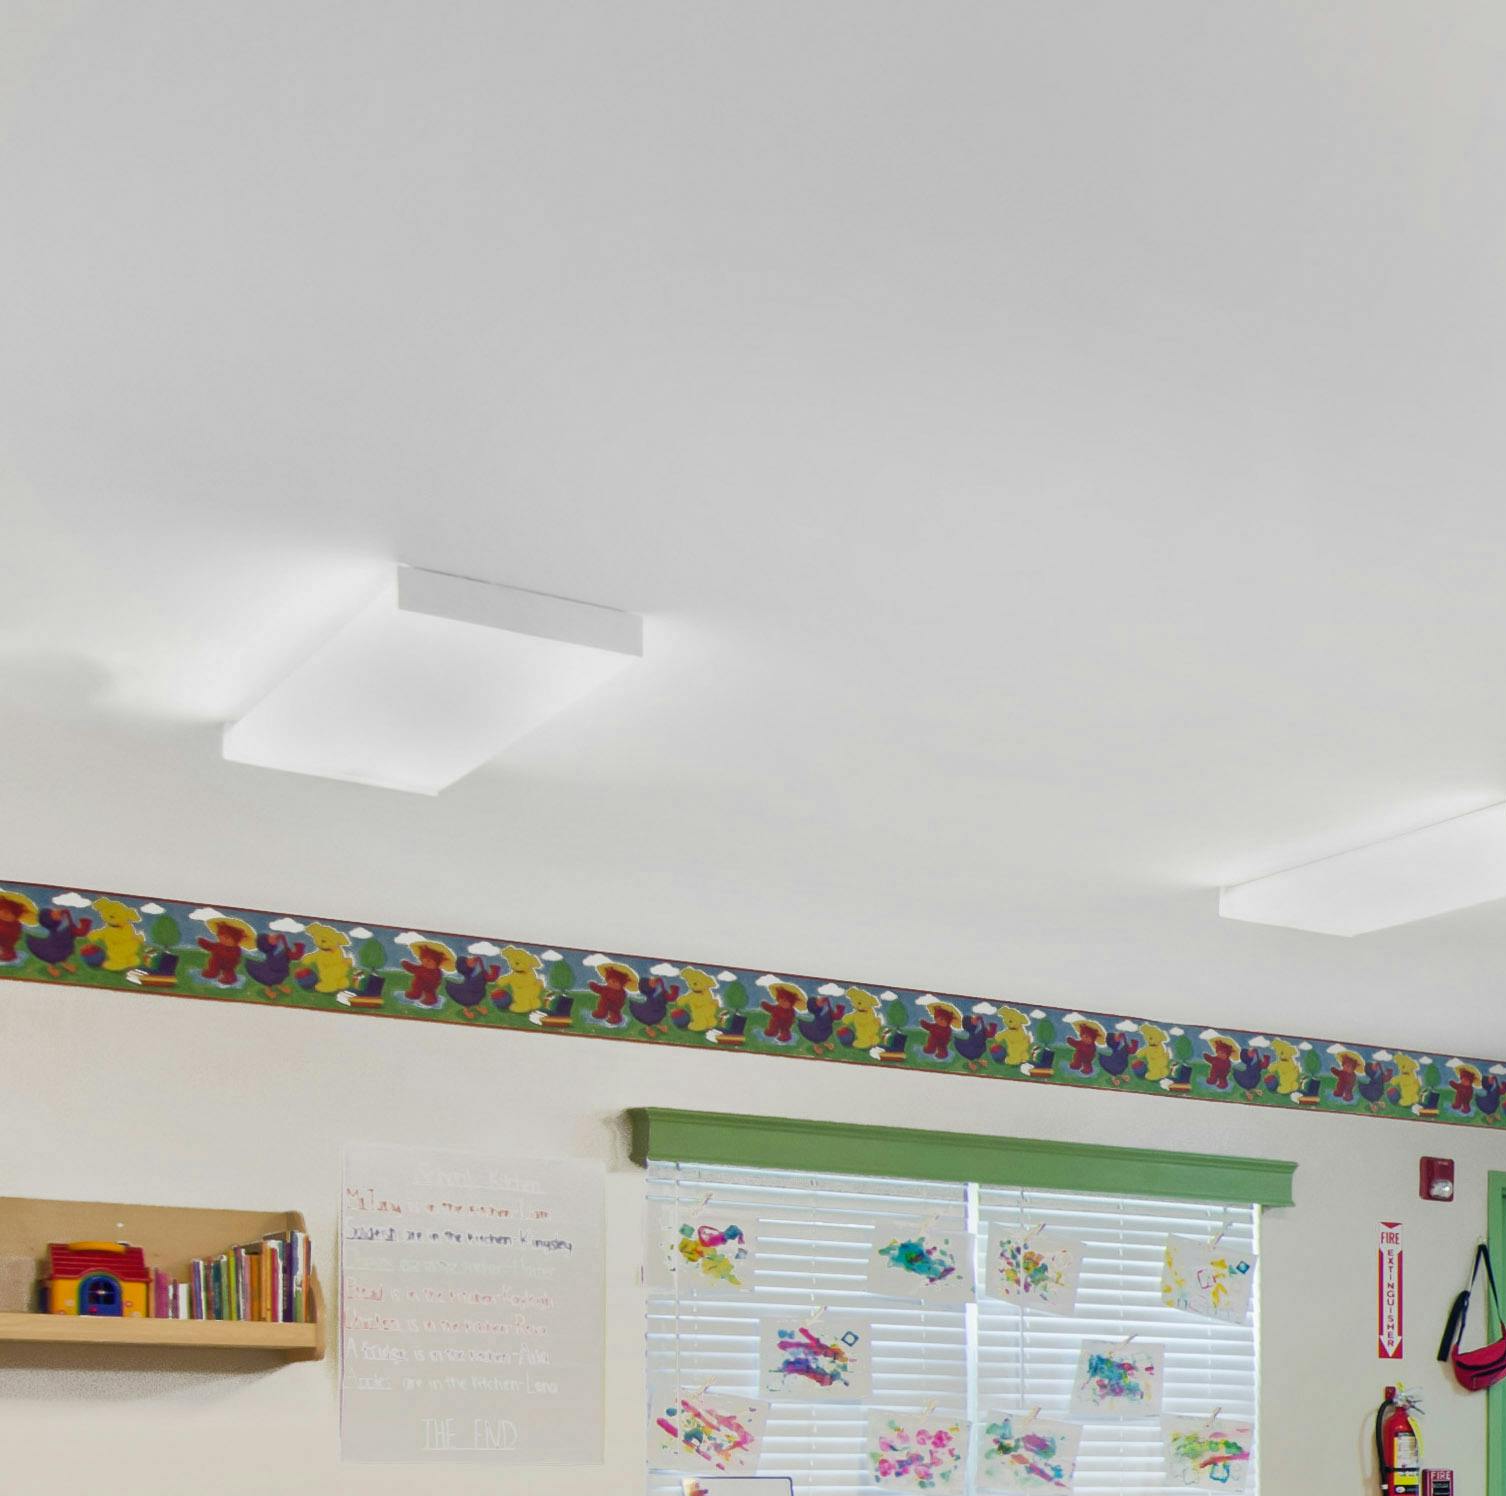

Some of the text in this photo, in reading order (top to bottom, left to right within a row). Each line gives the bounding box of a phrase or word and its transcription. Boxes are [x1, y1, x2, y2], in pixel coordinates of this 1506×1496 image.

[1380, 1232, 1400, 1245] FIRE
[1387, 1249, 1395, 1347] EXTINGUISHER
[1430, 1471, 1451, 1480] FIRE
